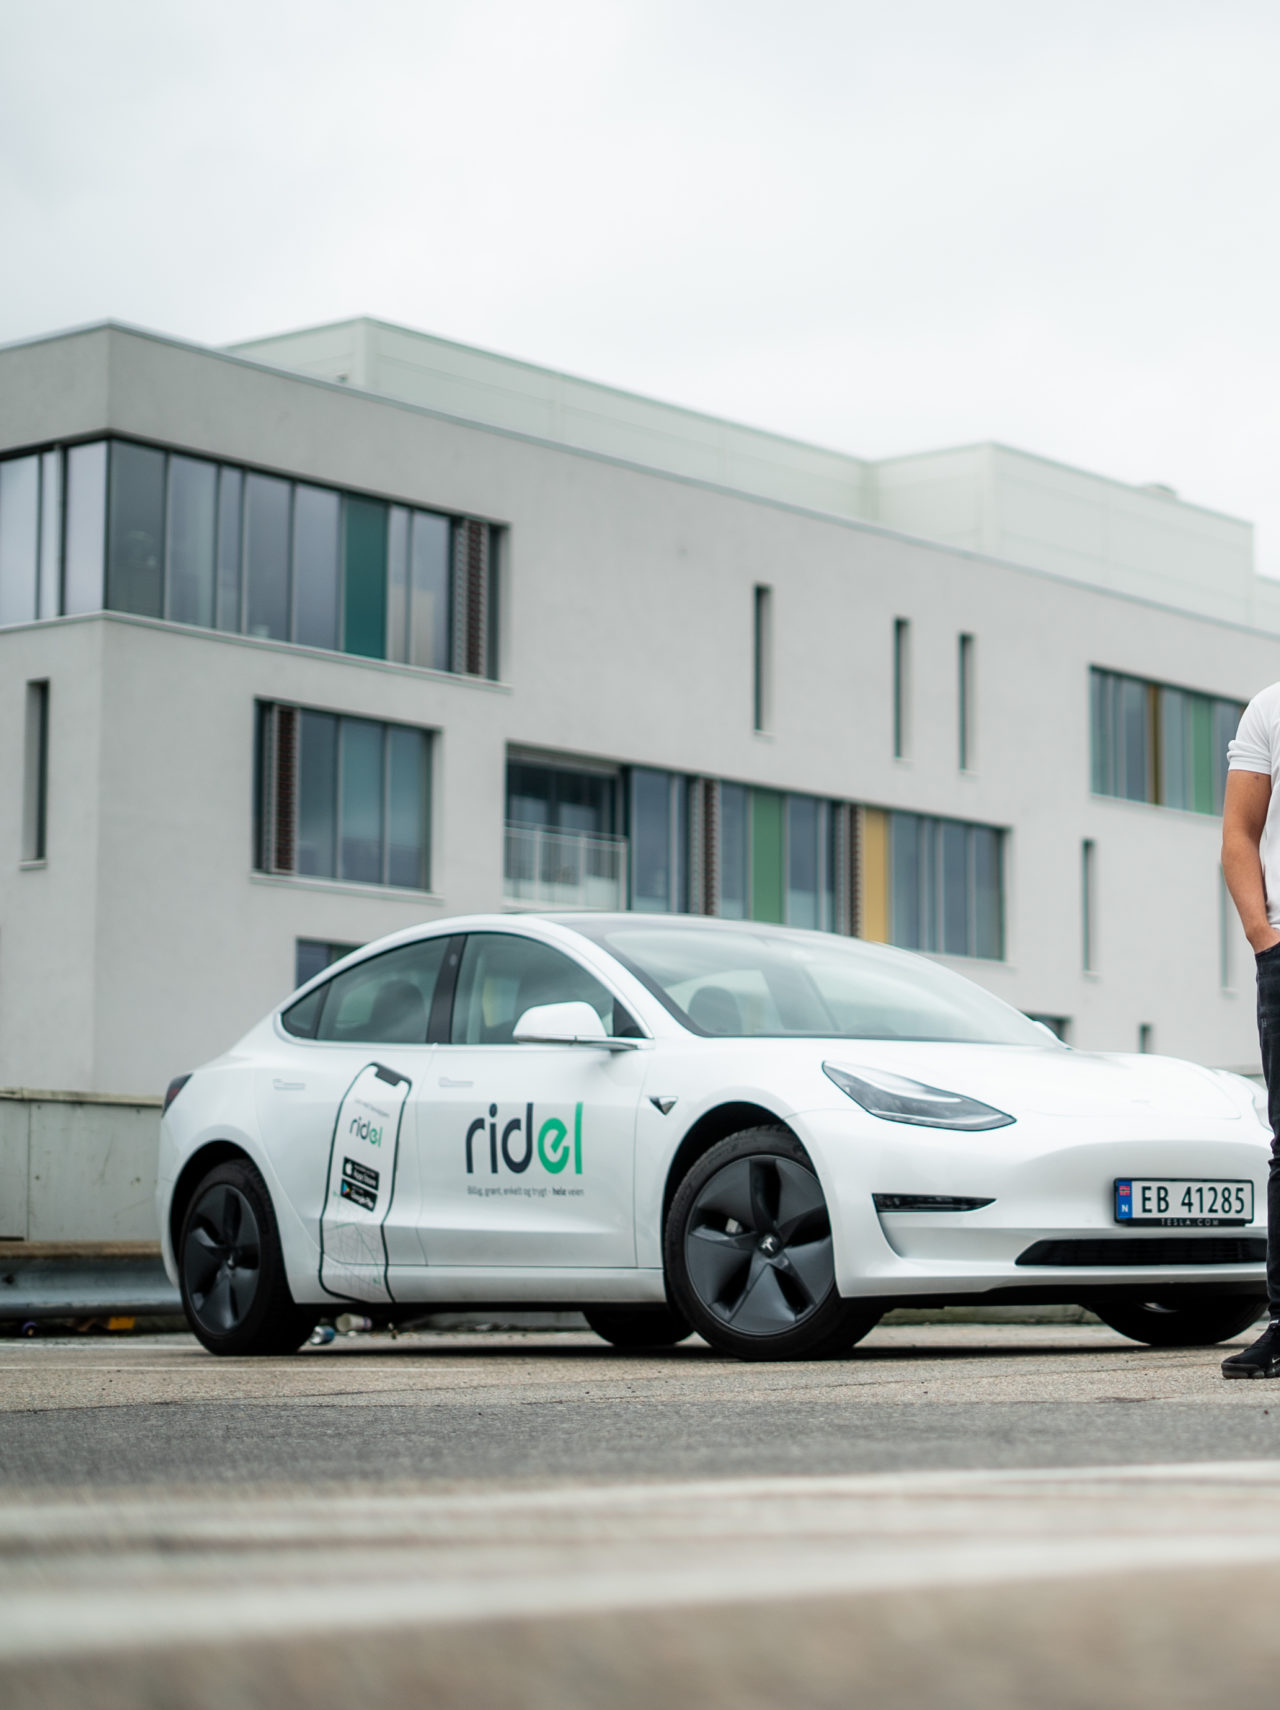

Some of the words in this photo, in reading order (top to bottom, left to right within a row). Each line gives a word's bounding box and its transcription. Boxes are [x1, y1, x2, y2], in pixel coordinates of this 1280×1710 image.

[349, 1116, 383, 1147] ridel
[465, 1101, 584, 1175] ridel
[1121, 1204, 1129, 1213] N
[1141, 1186, 1170, 1213] EB
[1181, 1186, 1245, 1214] 41285
[1161, 1218, 1219, 1226] TESLA.COM
